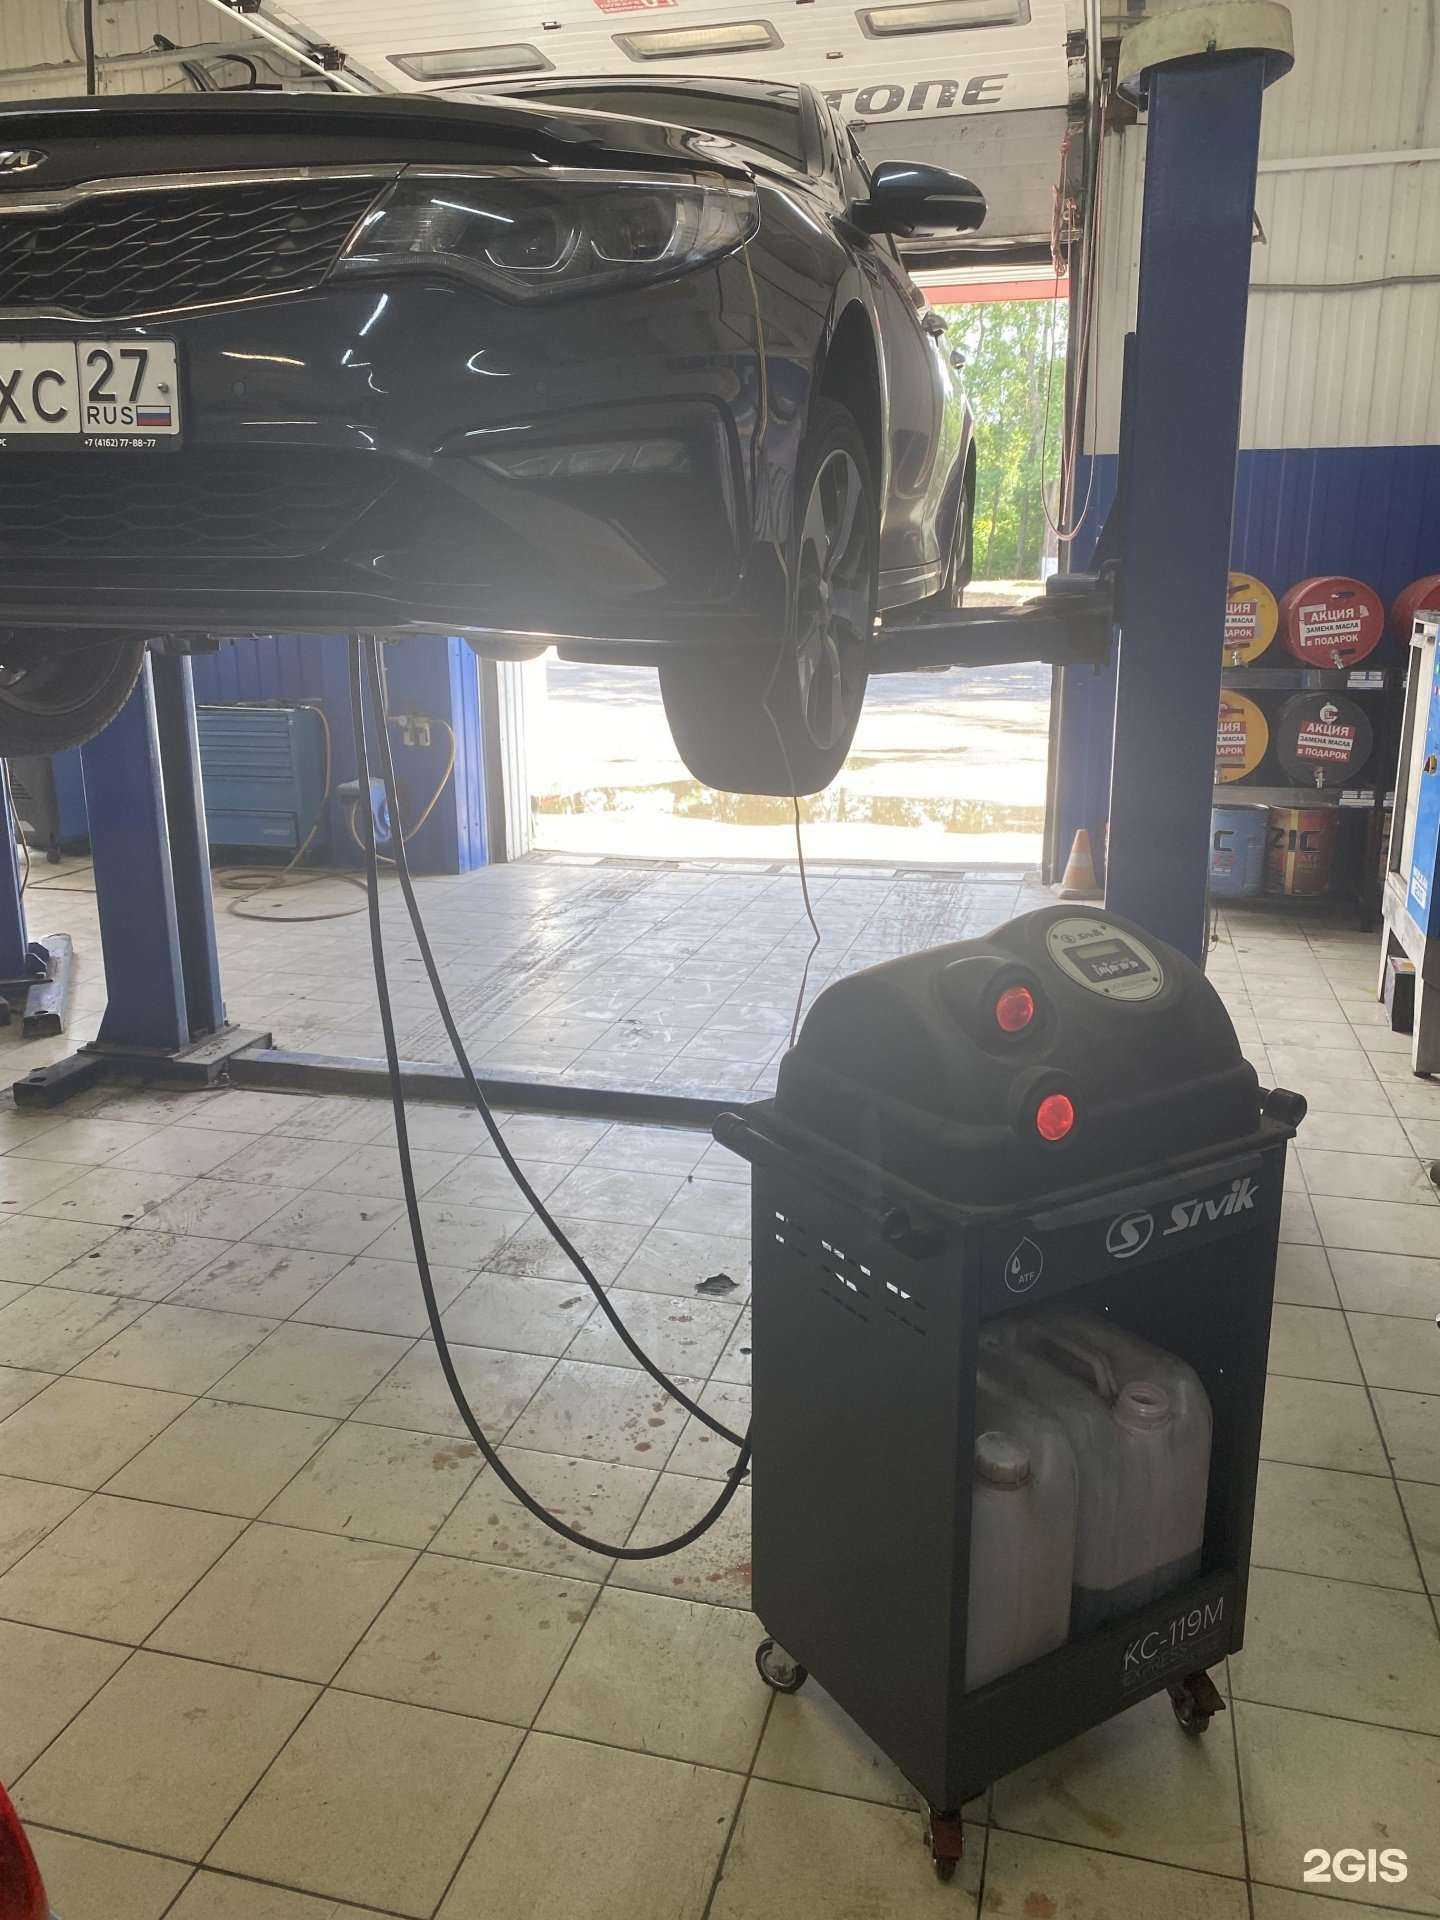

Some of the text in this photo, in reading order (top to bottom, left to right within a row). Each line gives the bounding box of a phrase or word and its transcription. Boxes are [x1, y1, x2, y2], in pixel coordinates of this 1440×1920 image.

[87, 348, 149, 402] 27
[87, 406, 134, 425] RUS
[84, 438, 157, 448] +7 (4162) 77-88-77
[1311, 608, 1355, 623] АКЦИЯ
[1306, 622, 1359, 633] ЗАМЕНА МАСЛА
[1315, 634, 1359, 647] ПОДАРОК
[1306, 723, 1349, 736] АКЦИЯ
[1300, 736, 1351, 748] ЗАМЕНА МАСЛА
[1305, 747, 1348, 760] ПОДАРОК
[1268, 826, 1322, 851] ZIC
[1017, 1271, 1035, 1284] ATF
